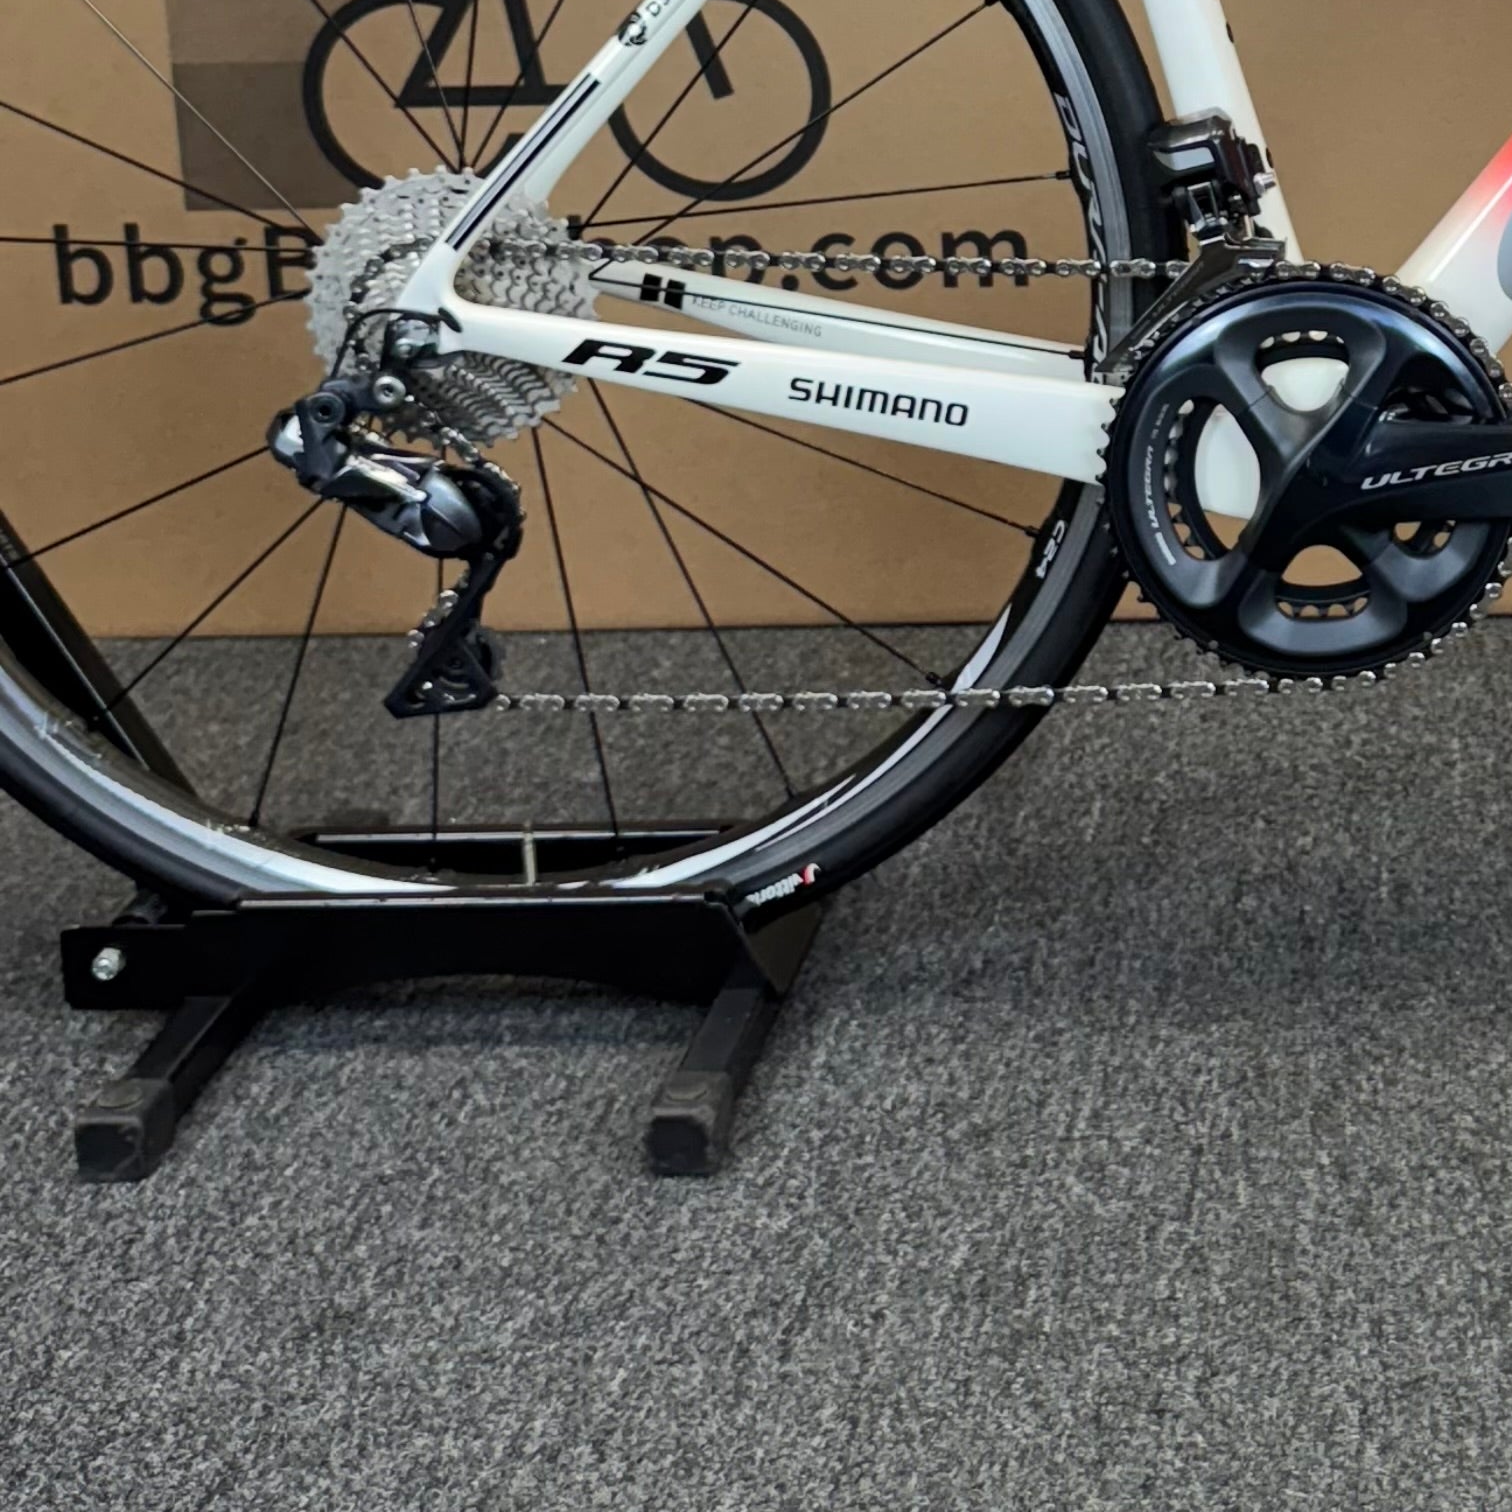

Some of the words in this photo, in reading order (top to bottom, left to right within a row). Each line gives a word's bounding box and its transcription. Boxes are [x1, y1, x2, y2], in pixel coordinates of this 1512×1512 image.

[727, 302, 824, 339] CHALLENGING
[562, 338, 741, 386] R5
[788, 377, 971, 428] SHIMANO
